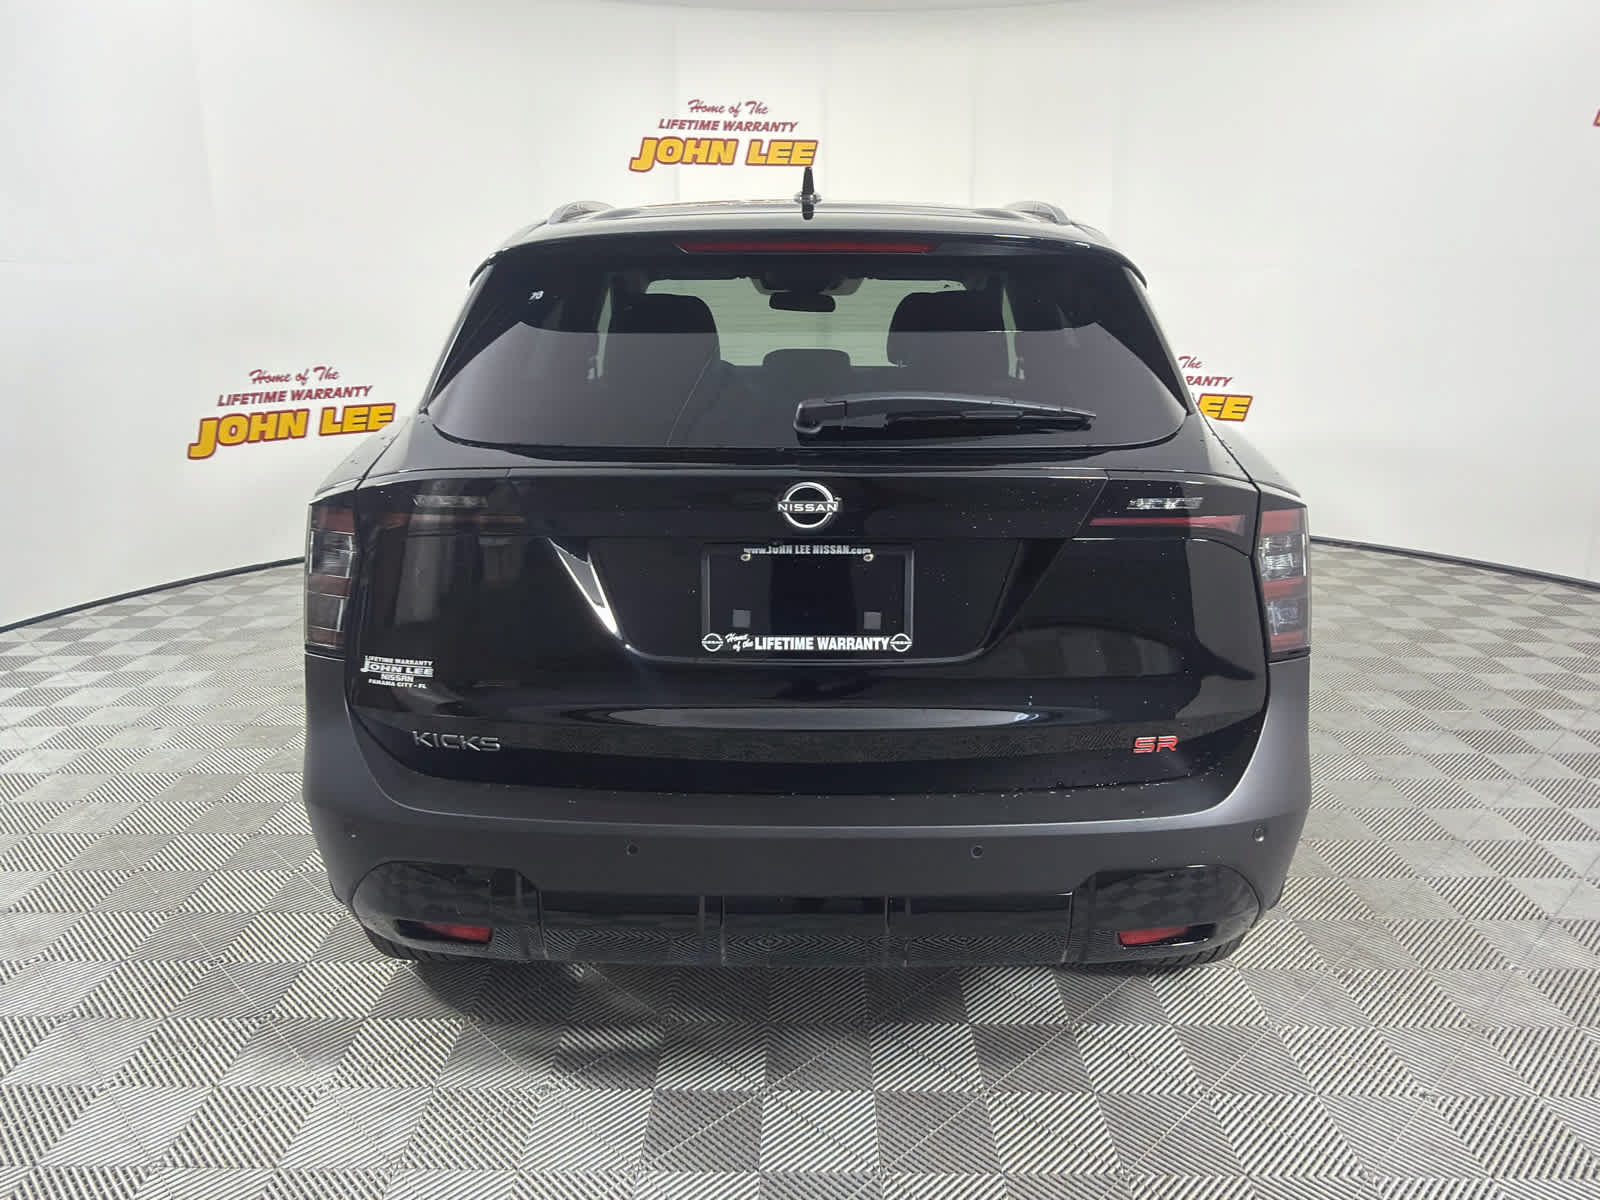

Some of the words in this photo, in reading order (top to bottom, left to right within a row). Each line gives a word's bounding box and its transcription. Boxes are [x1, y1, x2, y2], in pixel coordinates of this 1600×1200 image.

[688, 99, 725, 113] Home
[728, 102, 742, 117] of
[745, 100, 769, 114] The
[658, 118, 720, 131] LIFETIME
[723, 120, 798, 132] WARRANTY
[629, 136, 738, 172] JOHN
[745, 138, 819, 166] LEE
[1178, 355, 1202, 369] The
[249, 369, 292, 384] Home
[295, 368, 310, 386] of
[313, 366, 340, 380] The
[1185, 375, 1233, 387] RANTY
[217, 390, 287, 407] LIFETIME
[290, 385, 373, 401] WARRANTY
[1197, 393, 1254, 422] EE
[187, 408, 310, 460] JOHN
[318, 402, 396, 436] LEE
[777, 502, 838, 512] NISSAN
[795, 544, 811, 555] LEE
[725, 632, 748, 643] Home
[754, 636, 815, 651] LIFETIME
[817, 636, 890, 651] WARRANTY
[732, 641, 742, 652] of
[742, 639, 754, 648] the
[360, 655, 402, 673] JOHN
[405, 667, 434, 676] LEE
[394, 658, 433, 666] WARRANTY
[381, 673, 414, 682] NISSAN
[412, 730, 501, 751] KICKS
[1133, 735, 1179, 754] SR
